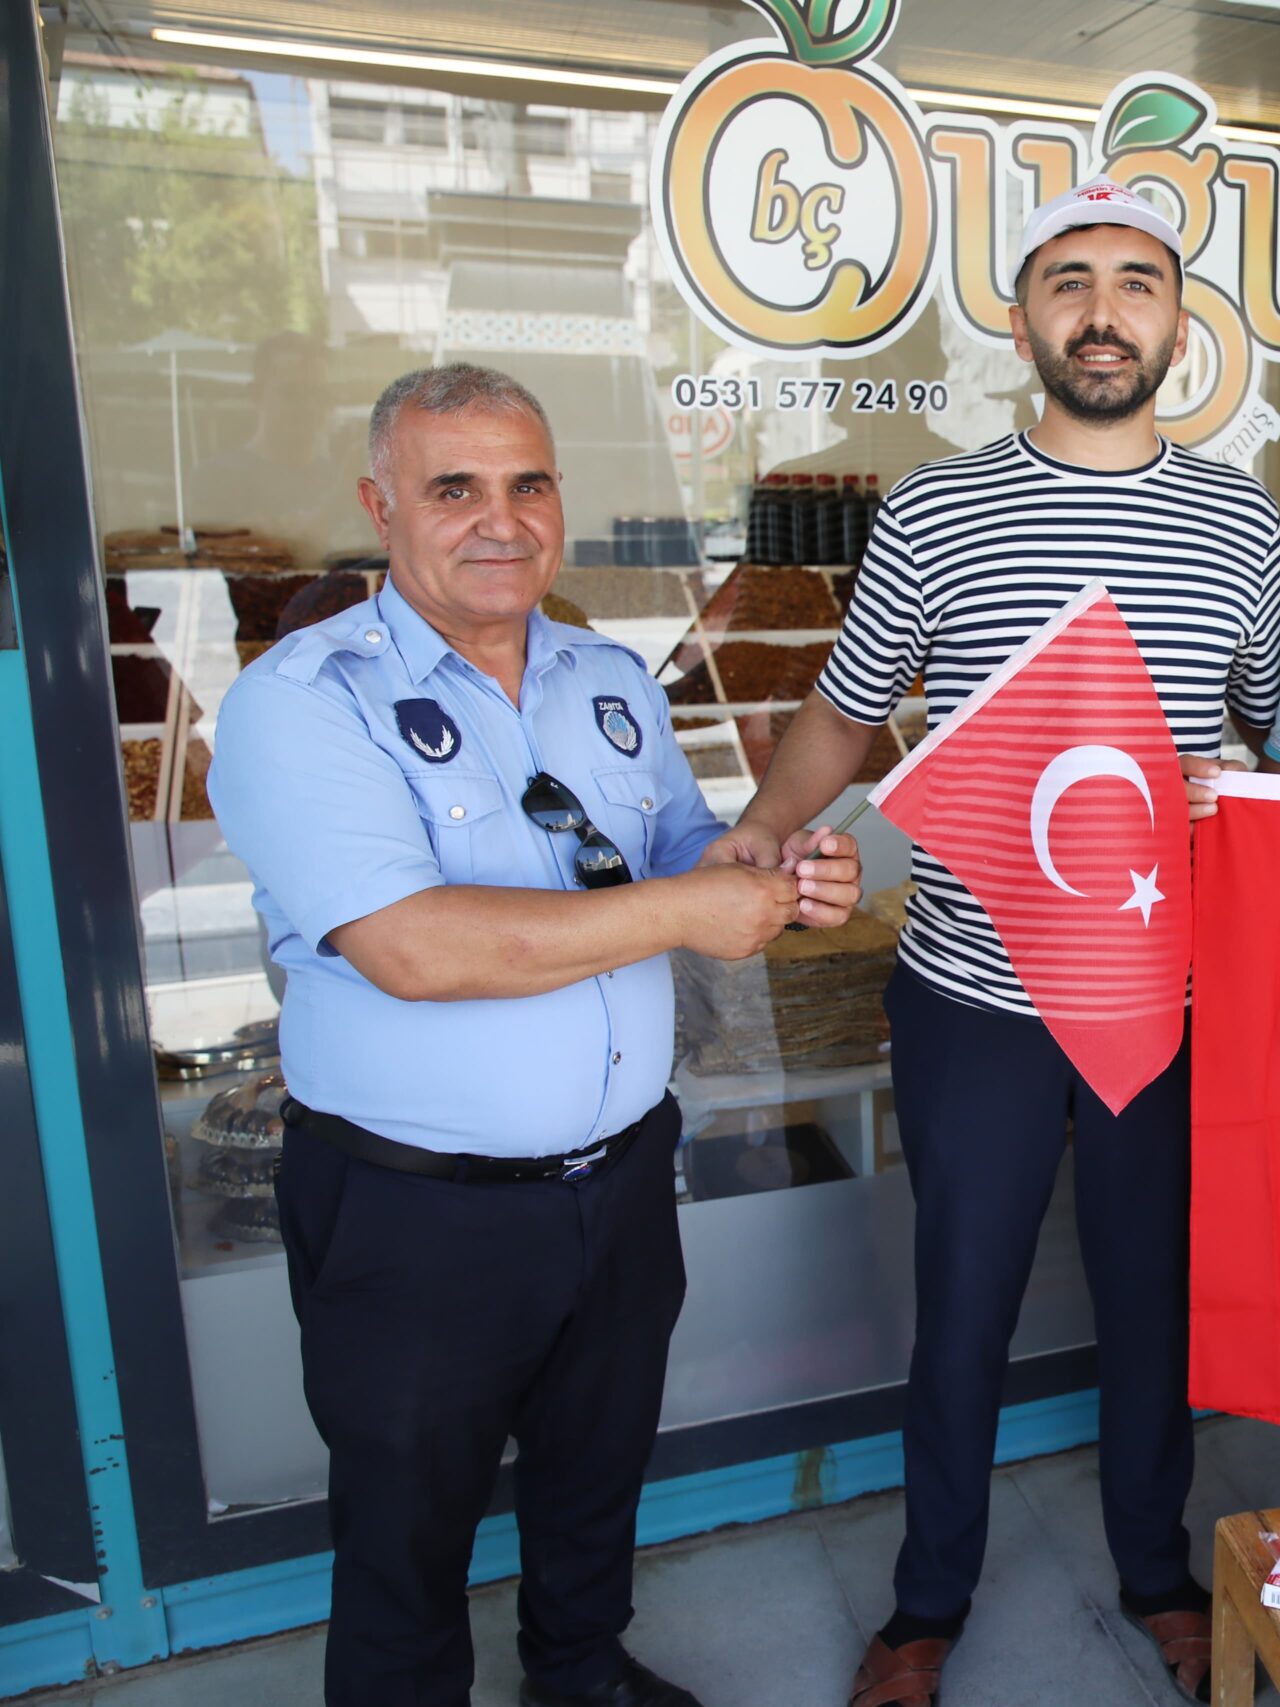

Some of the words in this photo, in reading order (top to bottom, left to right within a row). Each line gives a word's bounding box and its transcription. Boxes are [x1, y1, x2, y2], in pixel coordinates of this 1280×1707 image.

[750, 148, 845, 271] bç
[676, 379, 759, 407] 0531
[780, 382, 841, 408] 577
[855, 382, 896, 410] 24
[909, 384, 948, 410] 90
